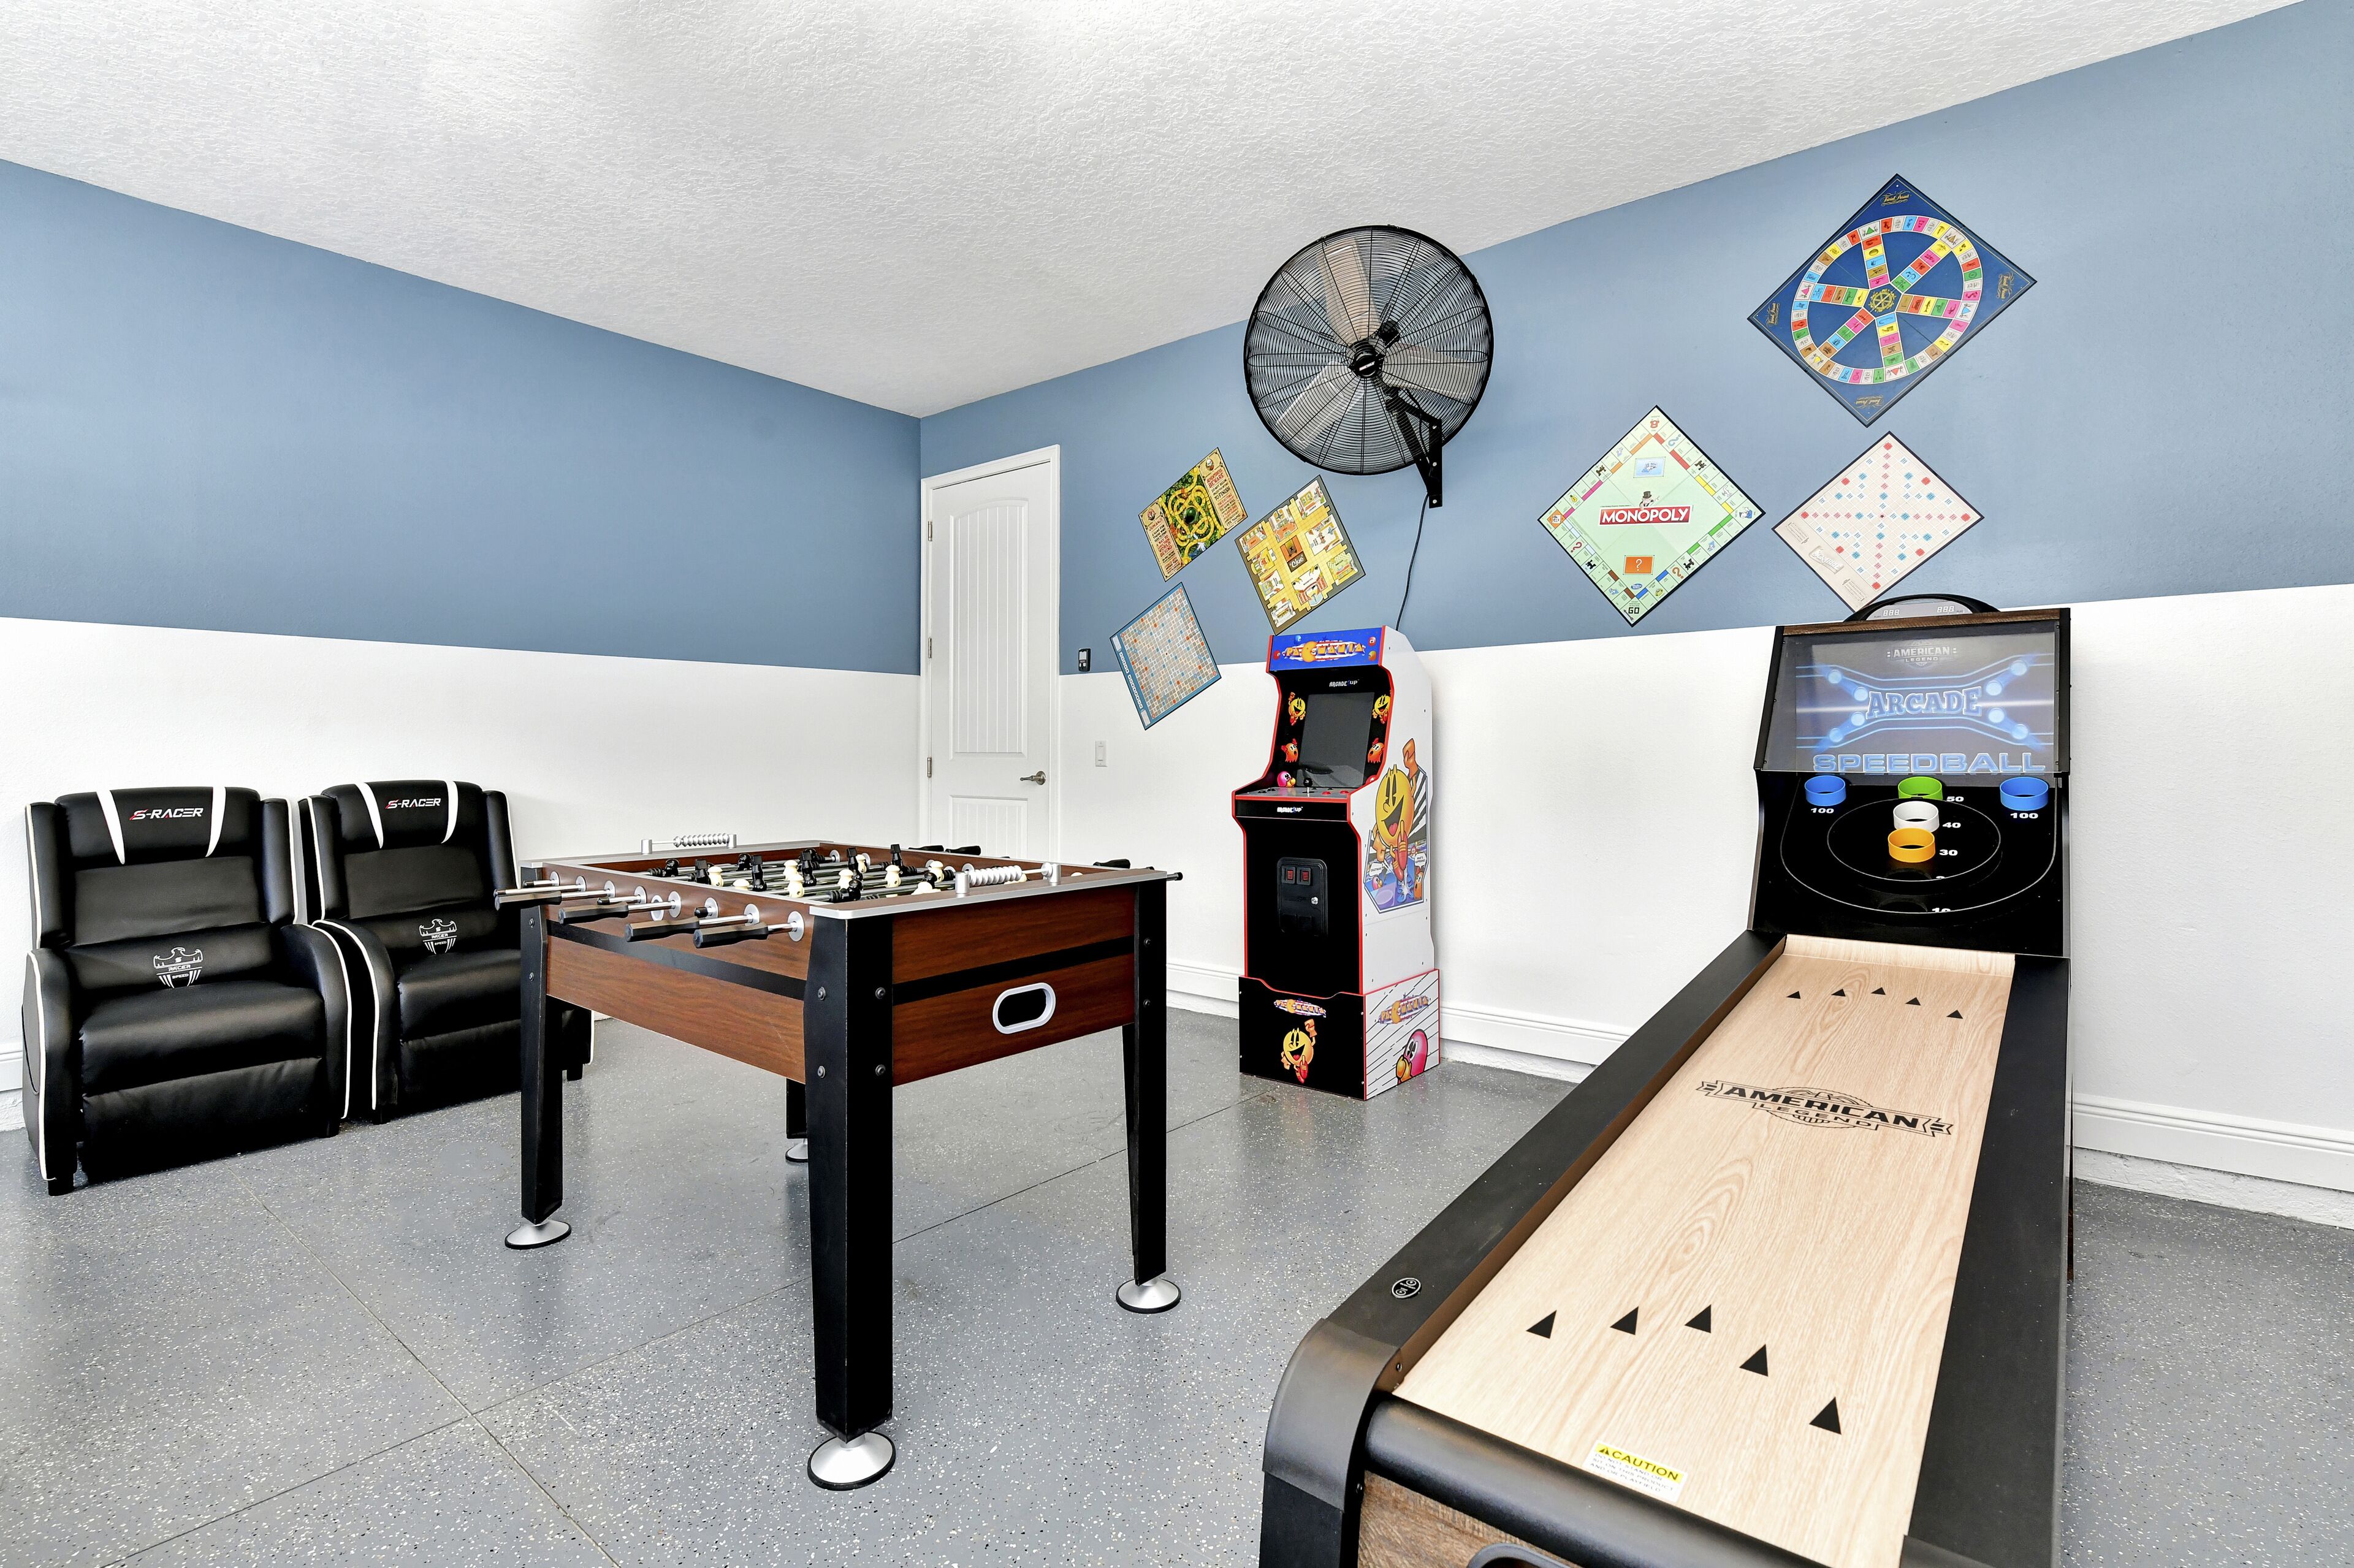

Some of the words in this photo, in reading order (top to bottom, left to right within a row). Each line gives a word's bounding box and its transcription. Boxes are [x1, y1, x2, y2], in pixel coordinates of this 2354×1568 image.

[1208, 473, 1224, 488] BEWARE
[1218, 485, 1230, 498] FINISH
[1602, 508, 1688, 523] MONOPOLY
[1893, 647, 1950, 658] AMERICAN
[1865, 686, 1982, 720] ARCADE
[1813, 753, 2046, 773] SPEEDBALL
[384, 798, 441, 809] S-RACER
[129, 807, 204, 821] S-RACER
[1723, 1086, 1919, 1128] AMERICAN
[1760, 1104, 1872, 1127] LEGEND
[1612, 1451, 1678, 1481] CAUTION
[1625, 1464, 1649, 1476] STAND
[1637, 1474, 1673, 1491] PRODUCT
